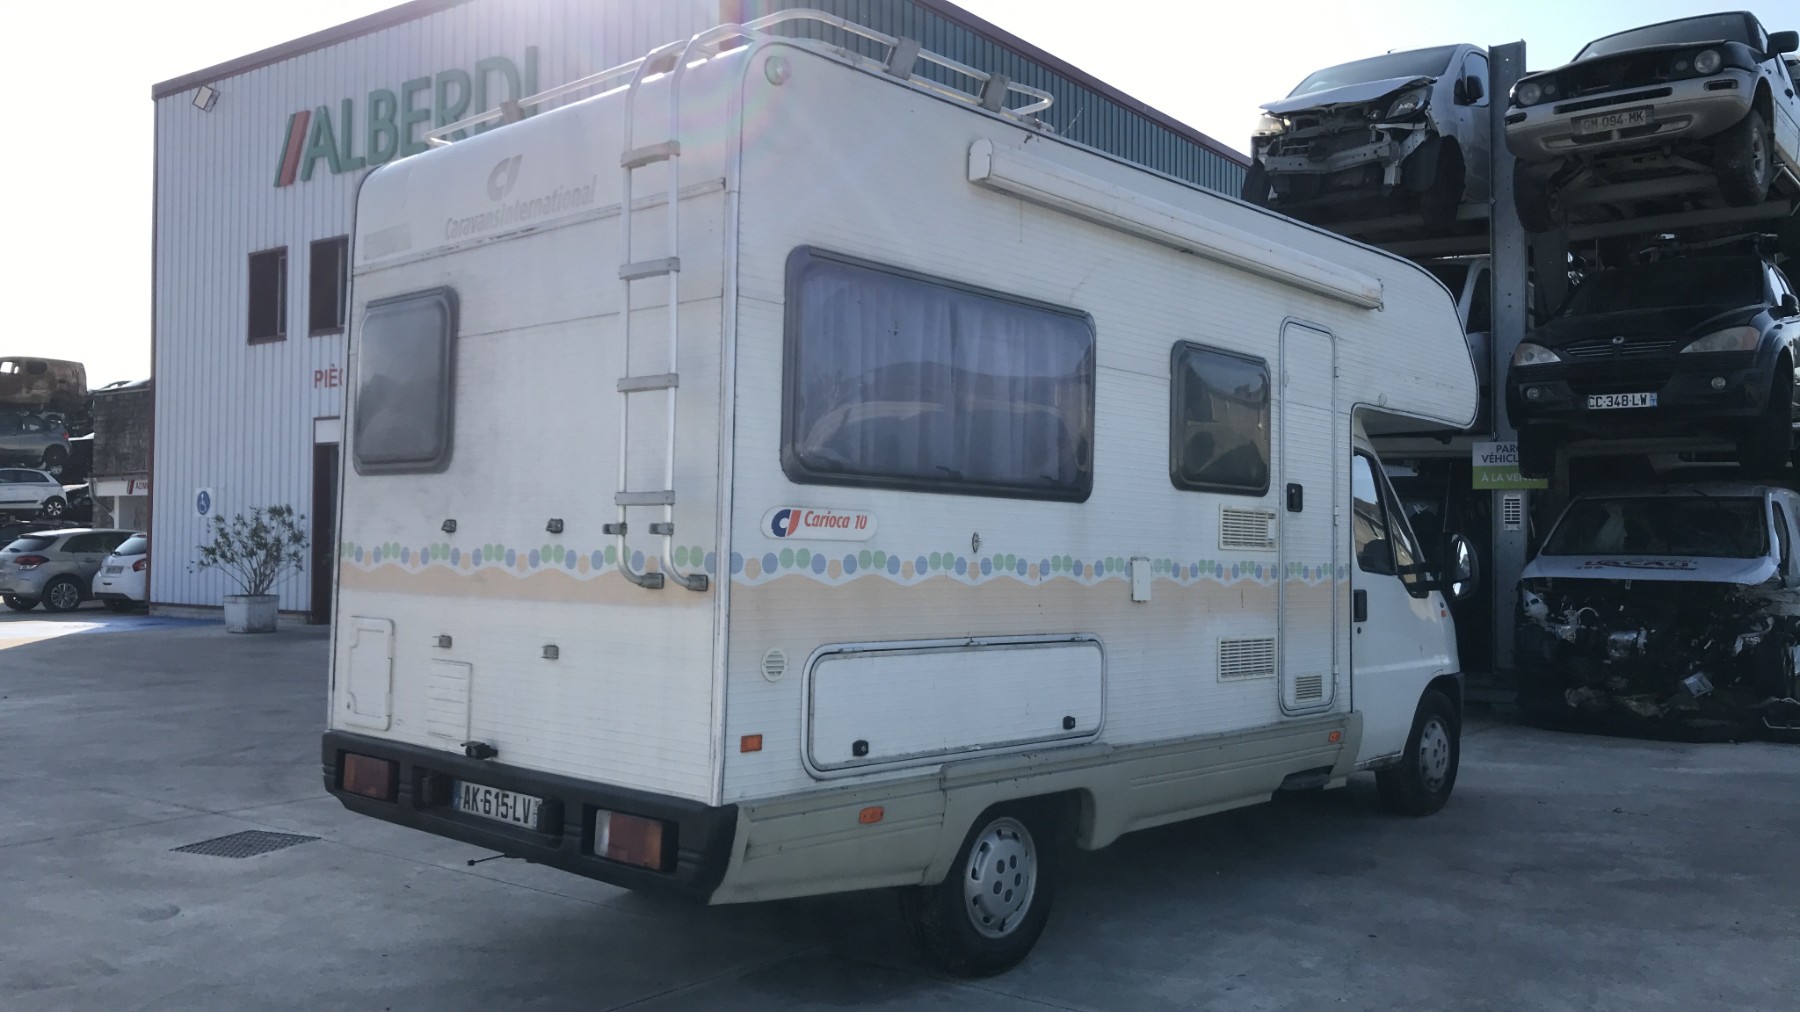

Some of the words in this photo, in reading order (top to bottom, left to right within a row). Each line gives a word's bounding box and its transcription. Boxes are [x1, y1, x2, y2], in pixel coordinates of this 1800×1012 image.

[300, 45, 538, 183] ALBERDI
[1482, 472, 1489, 482] À
[1491, 473, 1504, 482] LA
[804, 511, 850, 529] Carioca
[463, 785, 531, 824] AK-615-LV
